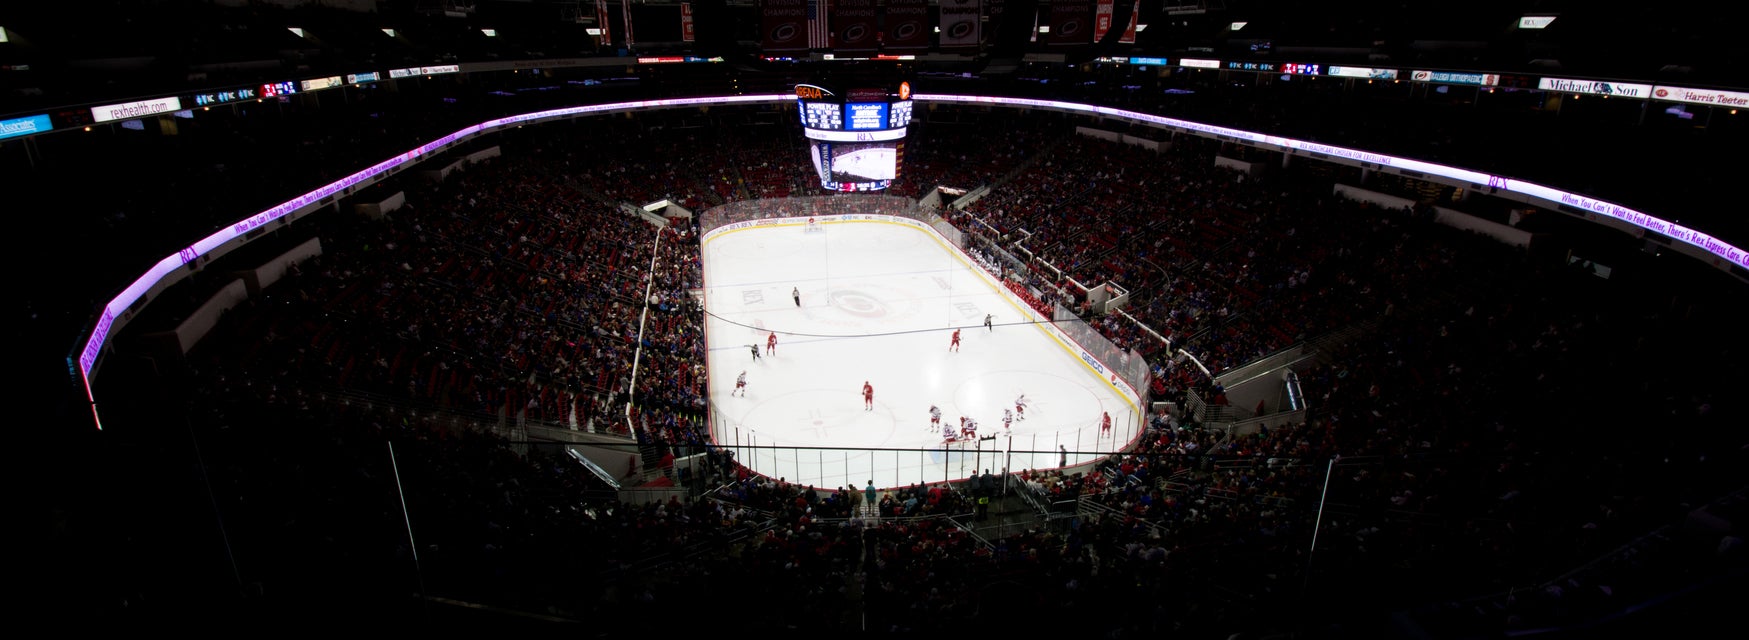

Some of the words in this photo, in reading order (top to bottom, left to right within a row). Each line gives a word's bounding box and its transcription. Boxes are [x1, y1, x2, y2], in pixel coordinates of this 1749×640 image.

[763, 8, 806, 16] CHAMPIONS
[796, 87, 822, 99] ARENA
[1549, 79, 1593, 93] Michael
[1615, 84, 1638, 96] Son
[1684, 91, 1715, 102] Harris
[1717, 94, 1748, 105] Teeter
[110, 101, 168, 119] rexhealth.com
[1488, 175, 1509, 189] REX
[1561, 193, 1578, 205] When
[1580, 198, 1591, 208] You
[1593, 202, 1611, 213] Can't
[1612, 206, 1626, 217] Wait
[1633, 213, 1646, 226] Feel
[1646, 218, 1666, 233] Better,
[1667, 224, 1690, 240] There's
[1691, 232, 1705, 246] Rex
[1705, 238, 1726, 255] Express
[180, 245, 198, 264] REX
[1082, 352, 1104, 374] GEICO
